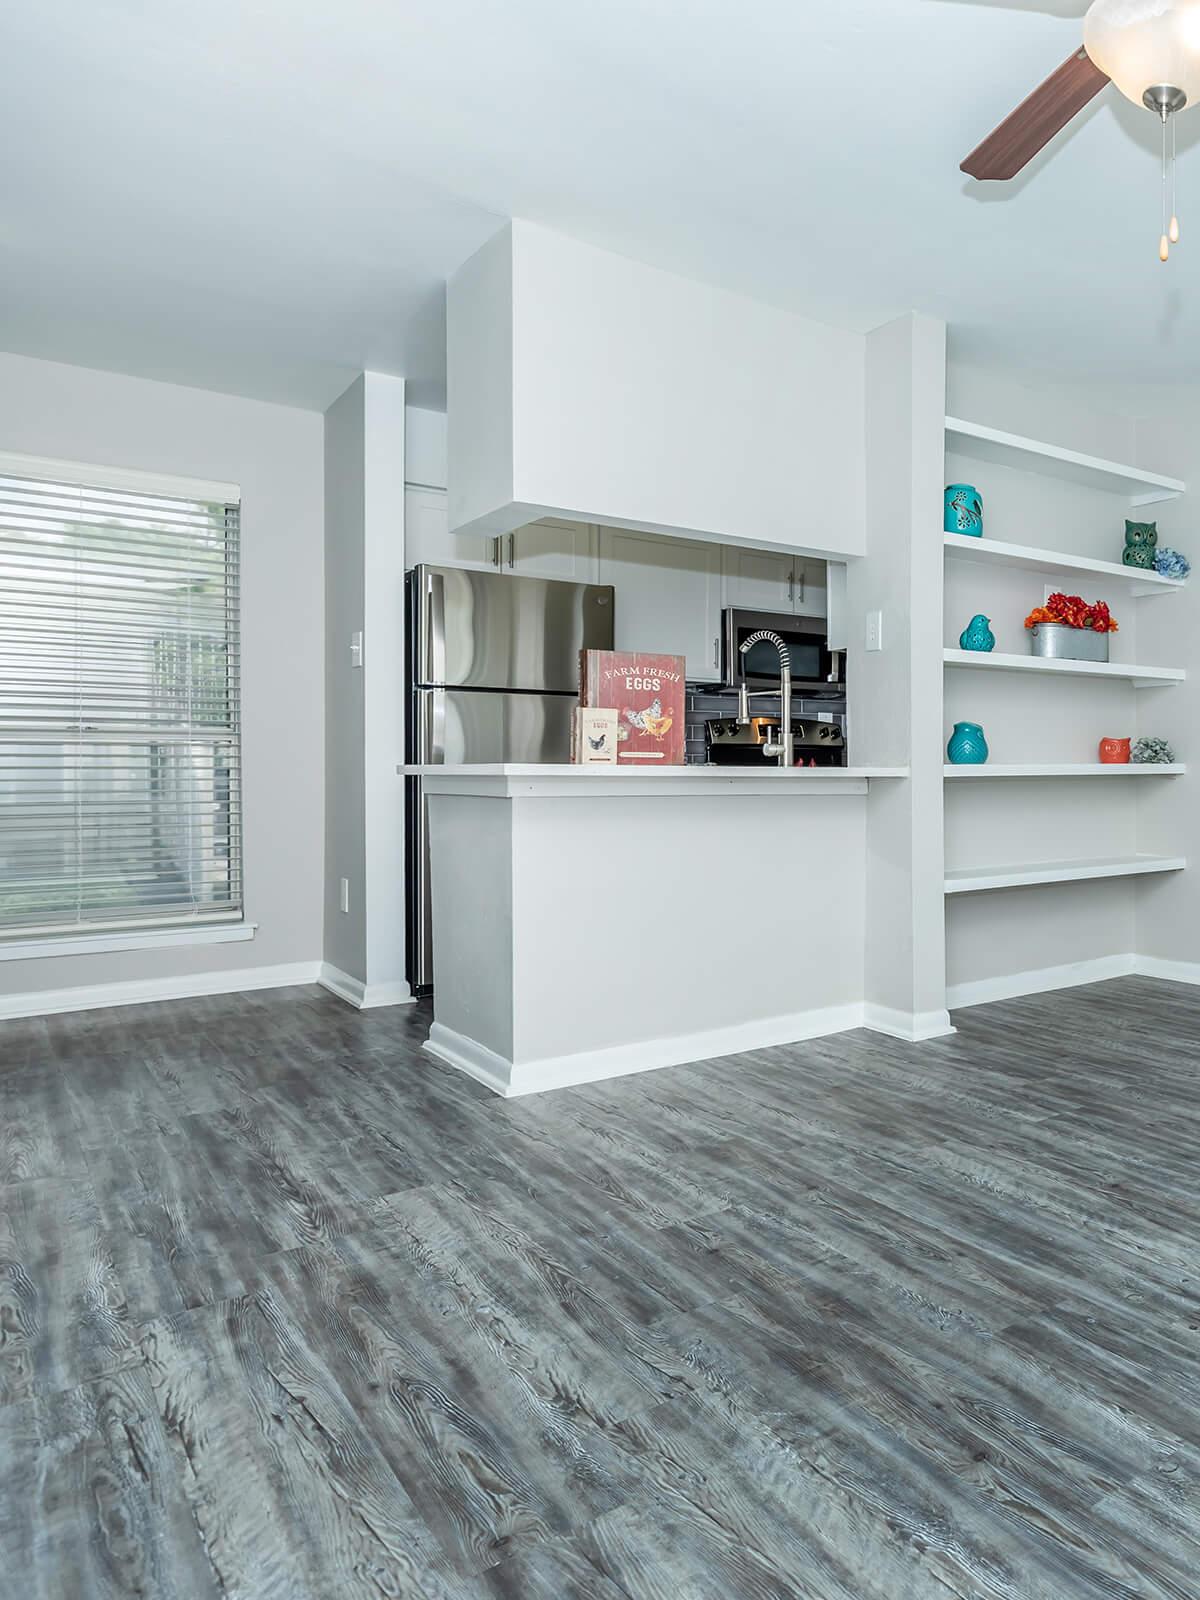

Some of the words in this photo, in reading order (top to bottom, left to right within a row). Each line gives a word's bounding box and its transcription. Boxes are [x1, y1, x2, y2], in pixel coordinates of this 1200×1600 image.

[604, 666, 640, 679] FARM
[643, 667, 680, 683] FRESH
[626, 677, 661, 692] EGGS
